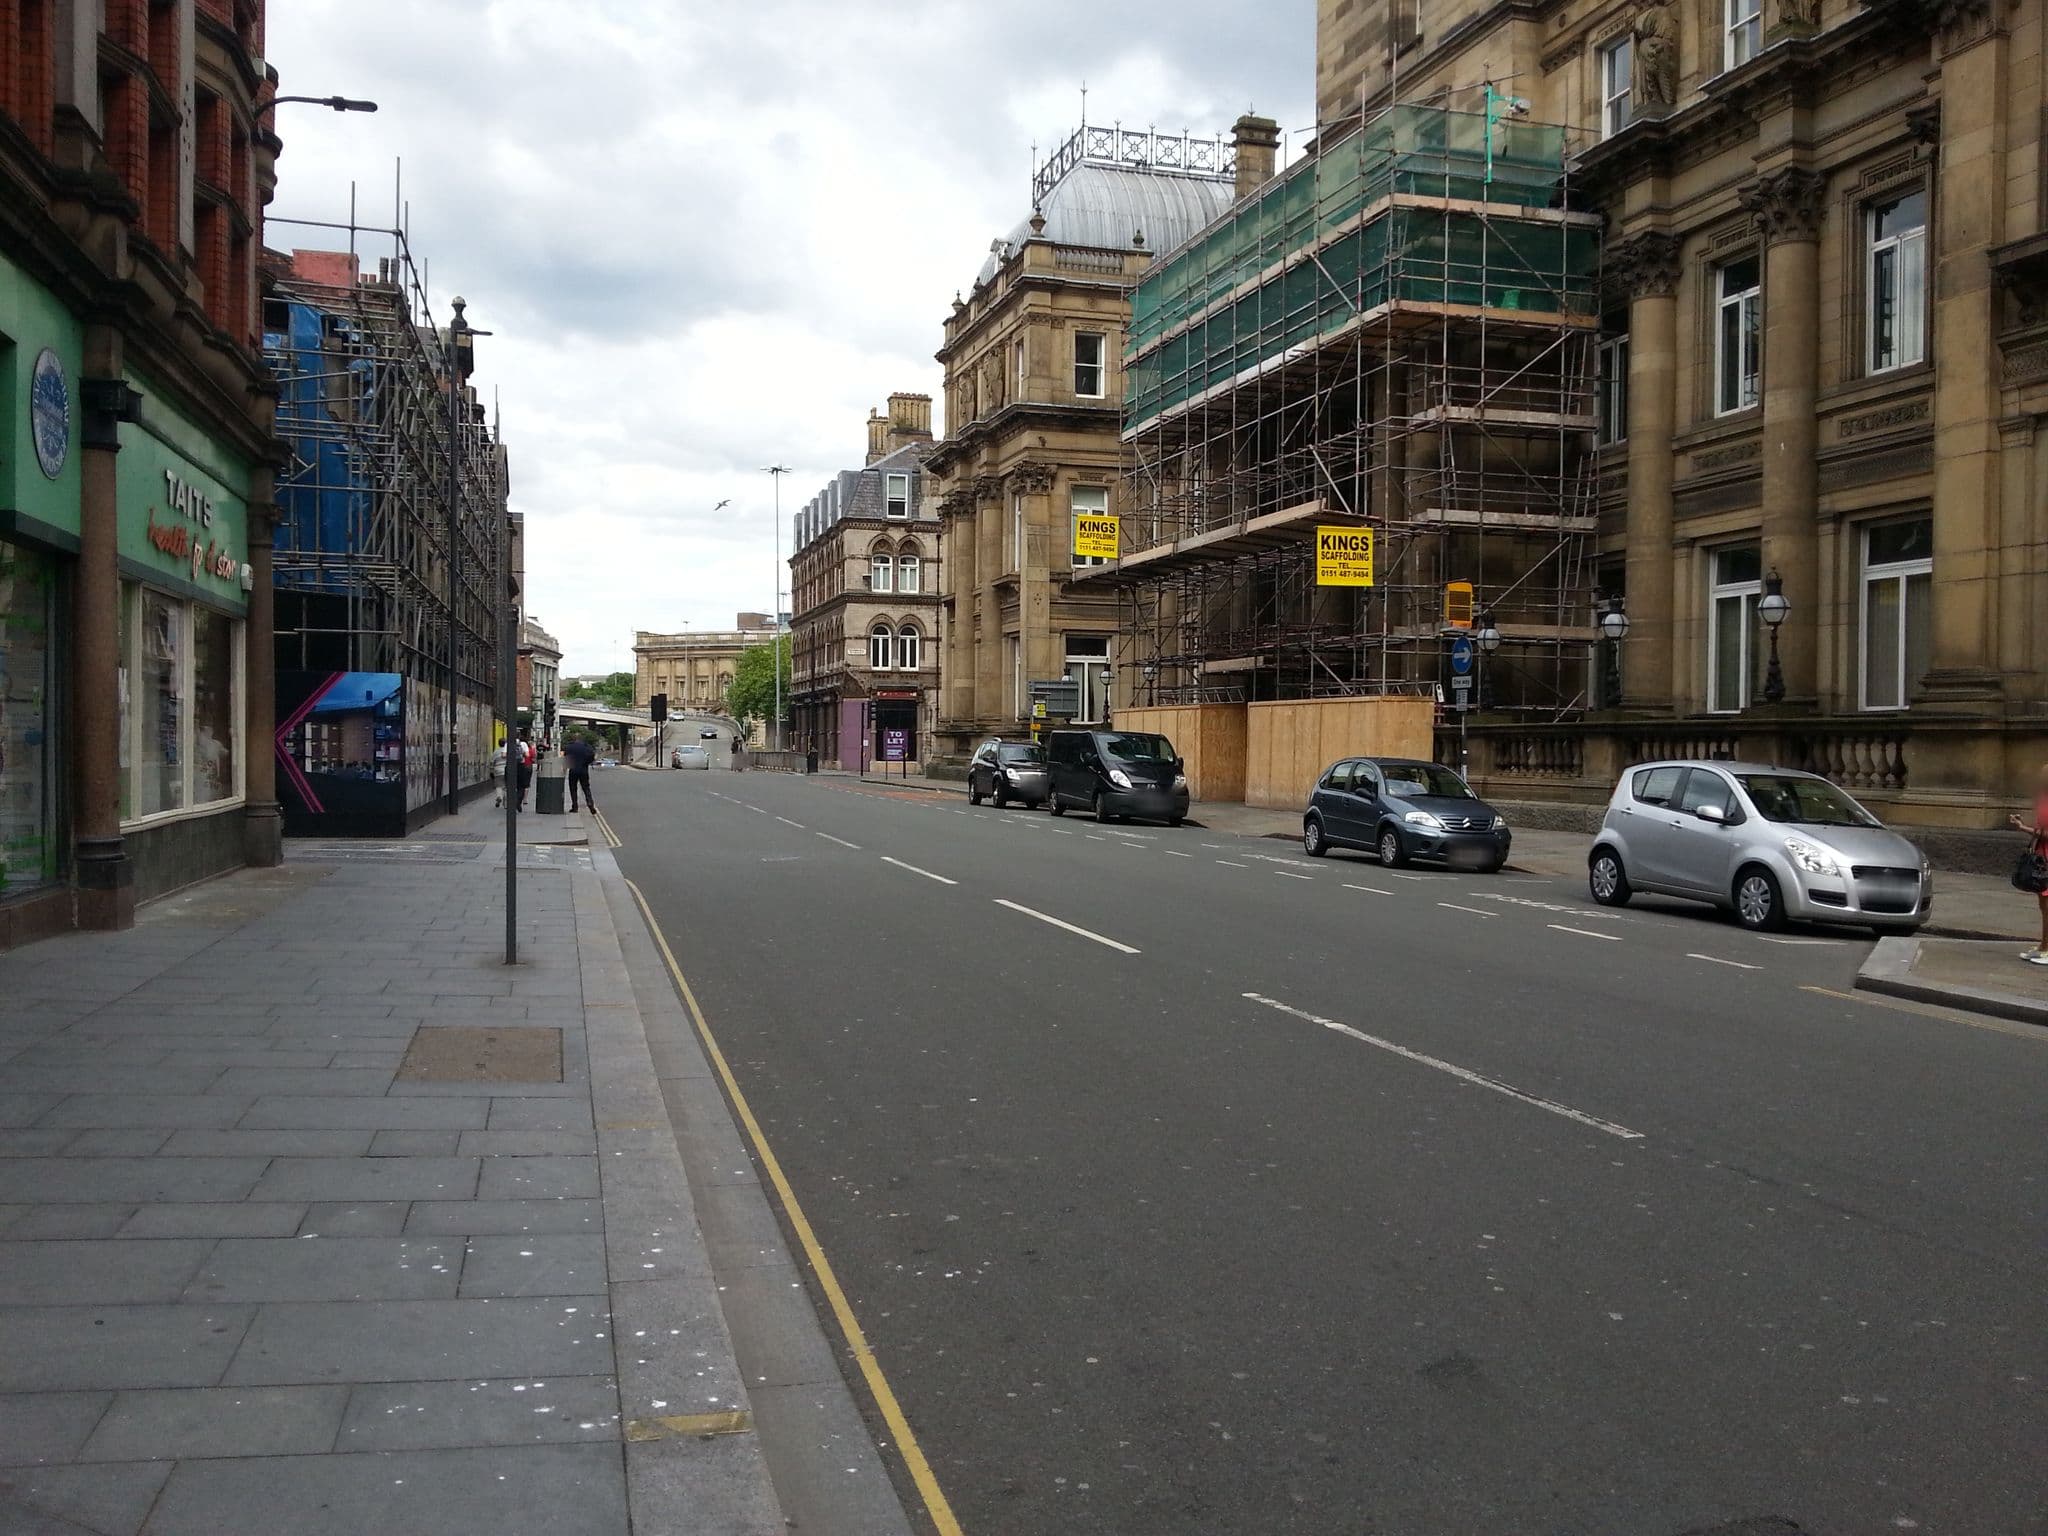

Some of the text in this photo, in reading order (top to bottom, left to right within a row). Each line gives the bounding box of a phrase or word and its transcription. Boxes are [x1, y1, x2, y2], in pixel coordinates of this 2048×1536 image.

[165, 468, 214, 529] TAITS
[1079, 520, 1116, 534] KINGS
[1079, 532, 1116, 541] SCAFFOLDING
[1321, 534, 1369, 551] KINGS
[1321, 551, 1370, 562] SCAFFOLDING
